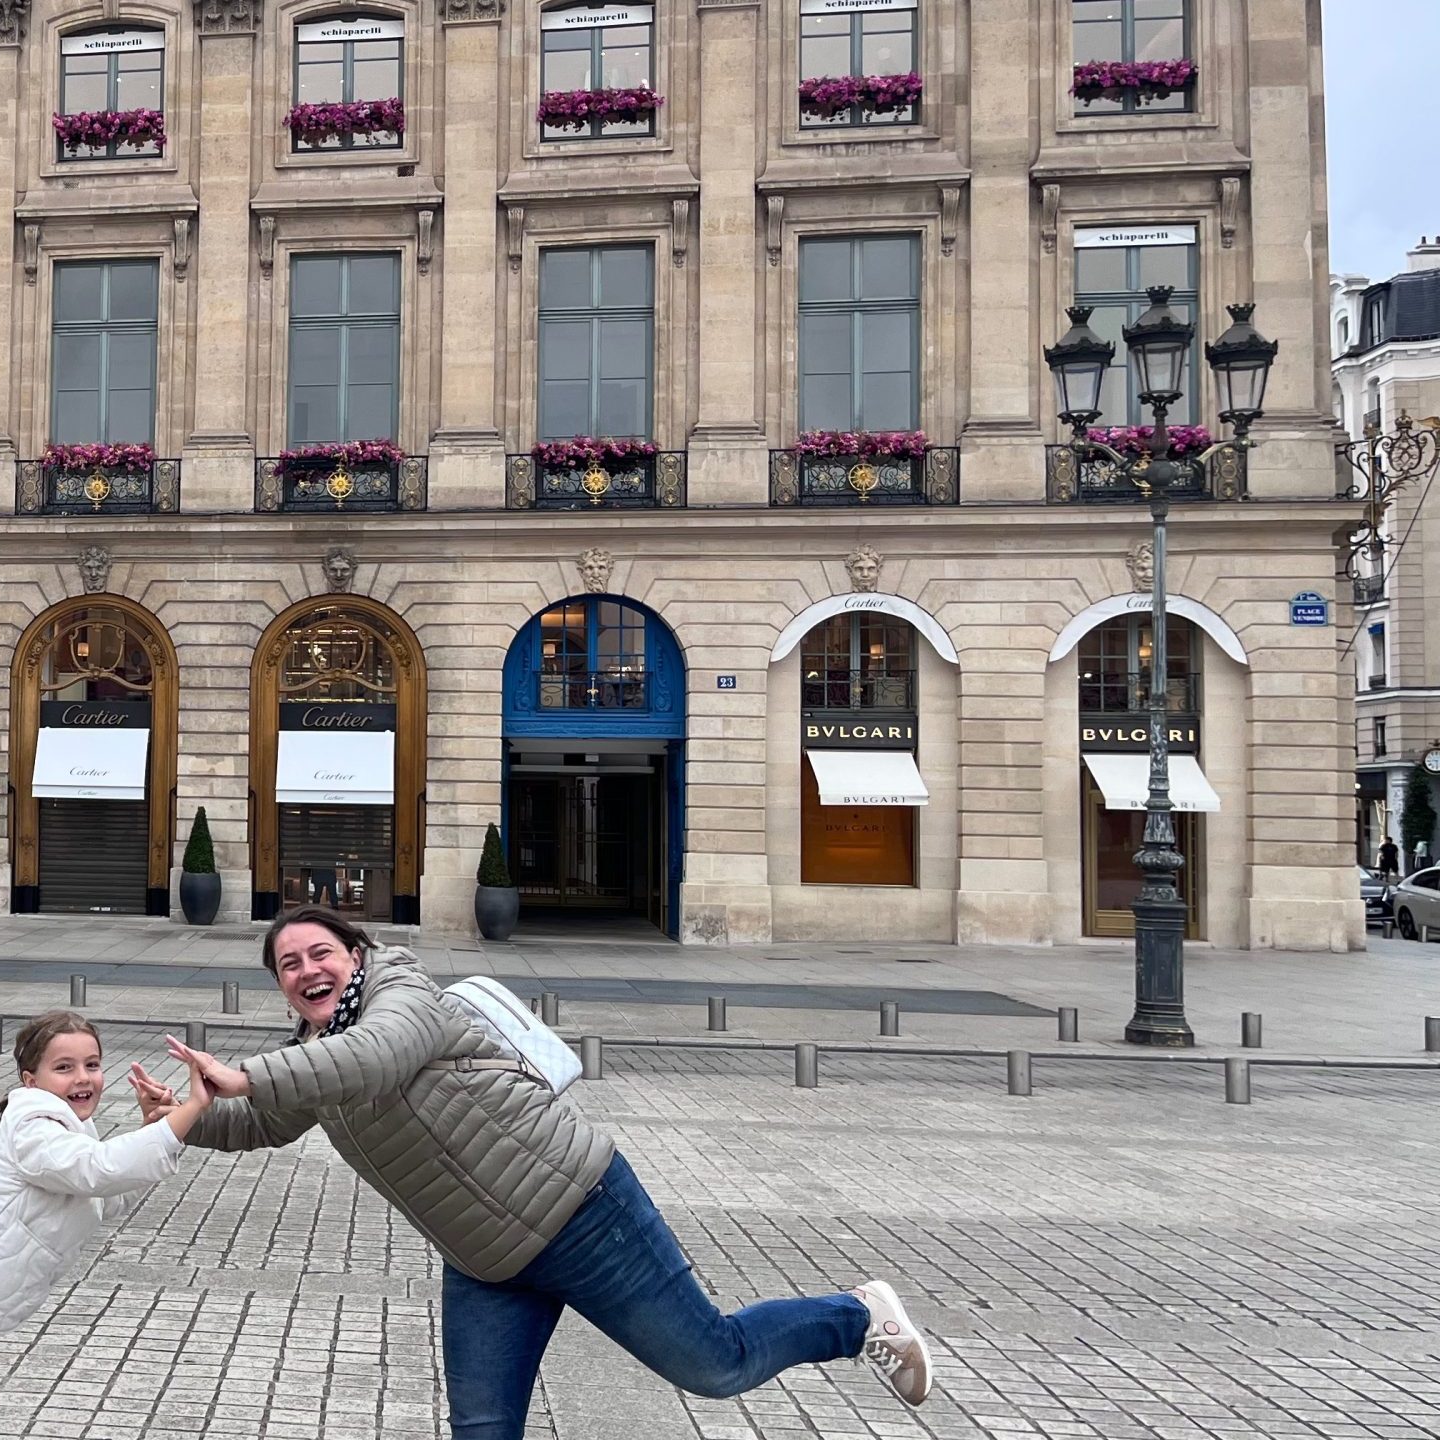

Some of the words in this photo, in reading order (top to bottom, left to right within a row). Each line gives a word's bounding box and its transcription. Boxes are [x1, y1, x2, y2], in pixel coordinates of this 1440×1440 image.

[565, 12, 628, 24] schiaparelli
[321, 27, 381, 38] schiaparelli
[84, 38, 142, 50] schiaparelli
[1099, 232, 1169, 244] schiaparelli
[844, 596, 887, 609] Cartier
[720, 677, 734, 688] 23
[62, 705, 129, 725] Cartier
[302, 706, 373, 727] Cartier
[807, 725, 912, 738] BVLGARI
[1083, 728, 1195, 741] BVLGRI
[69, 766, 111, 777] Cartier
[313, 770, 357, 782] Cartier
[843, 796, 906, 804] BVLGARI
